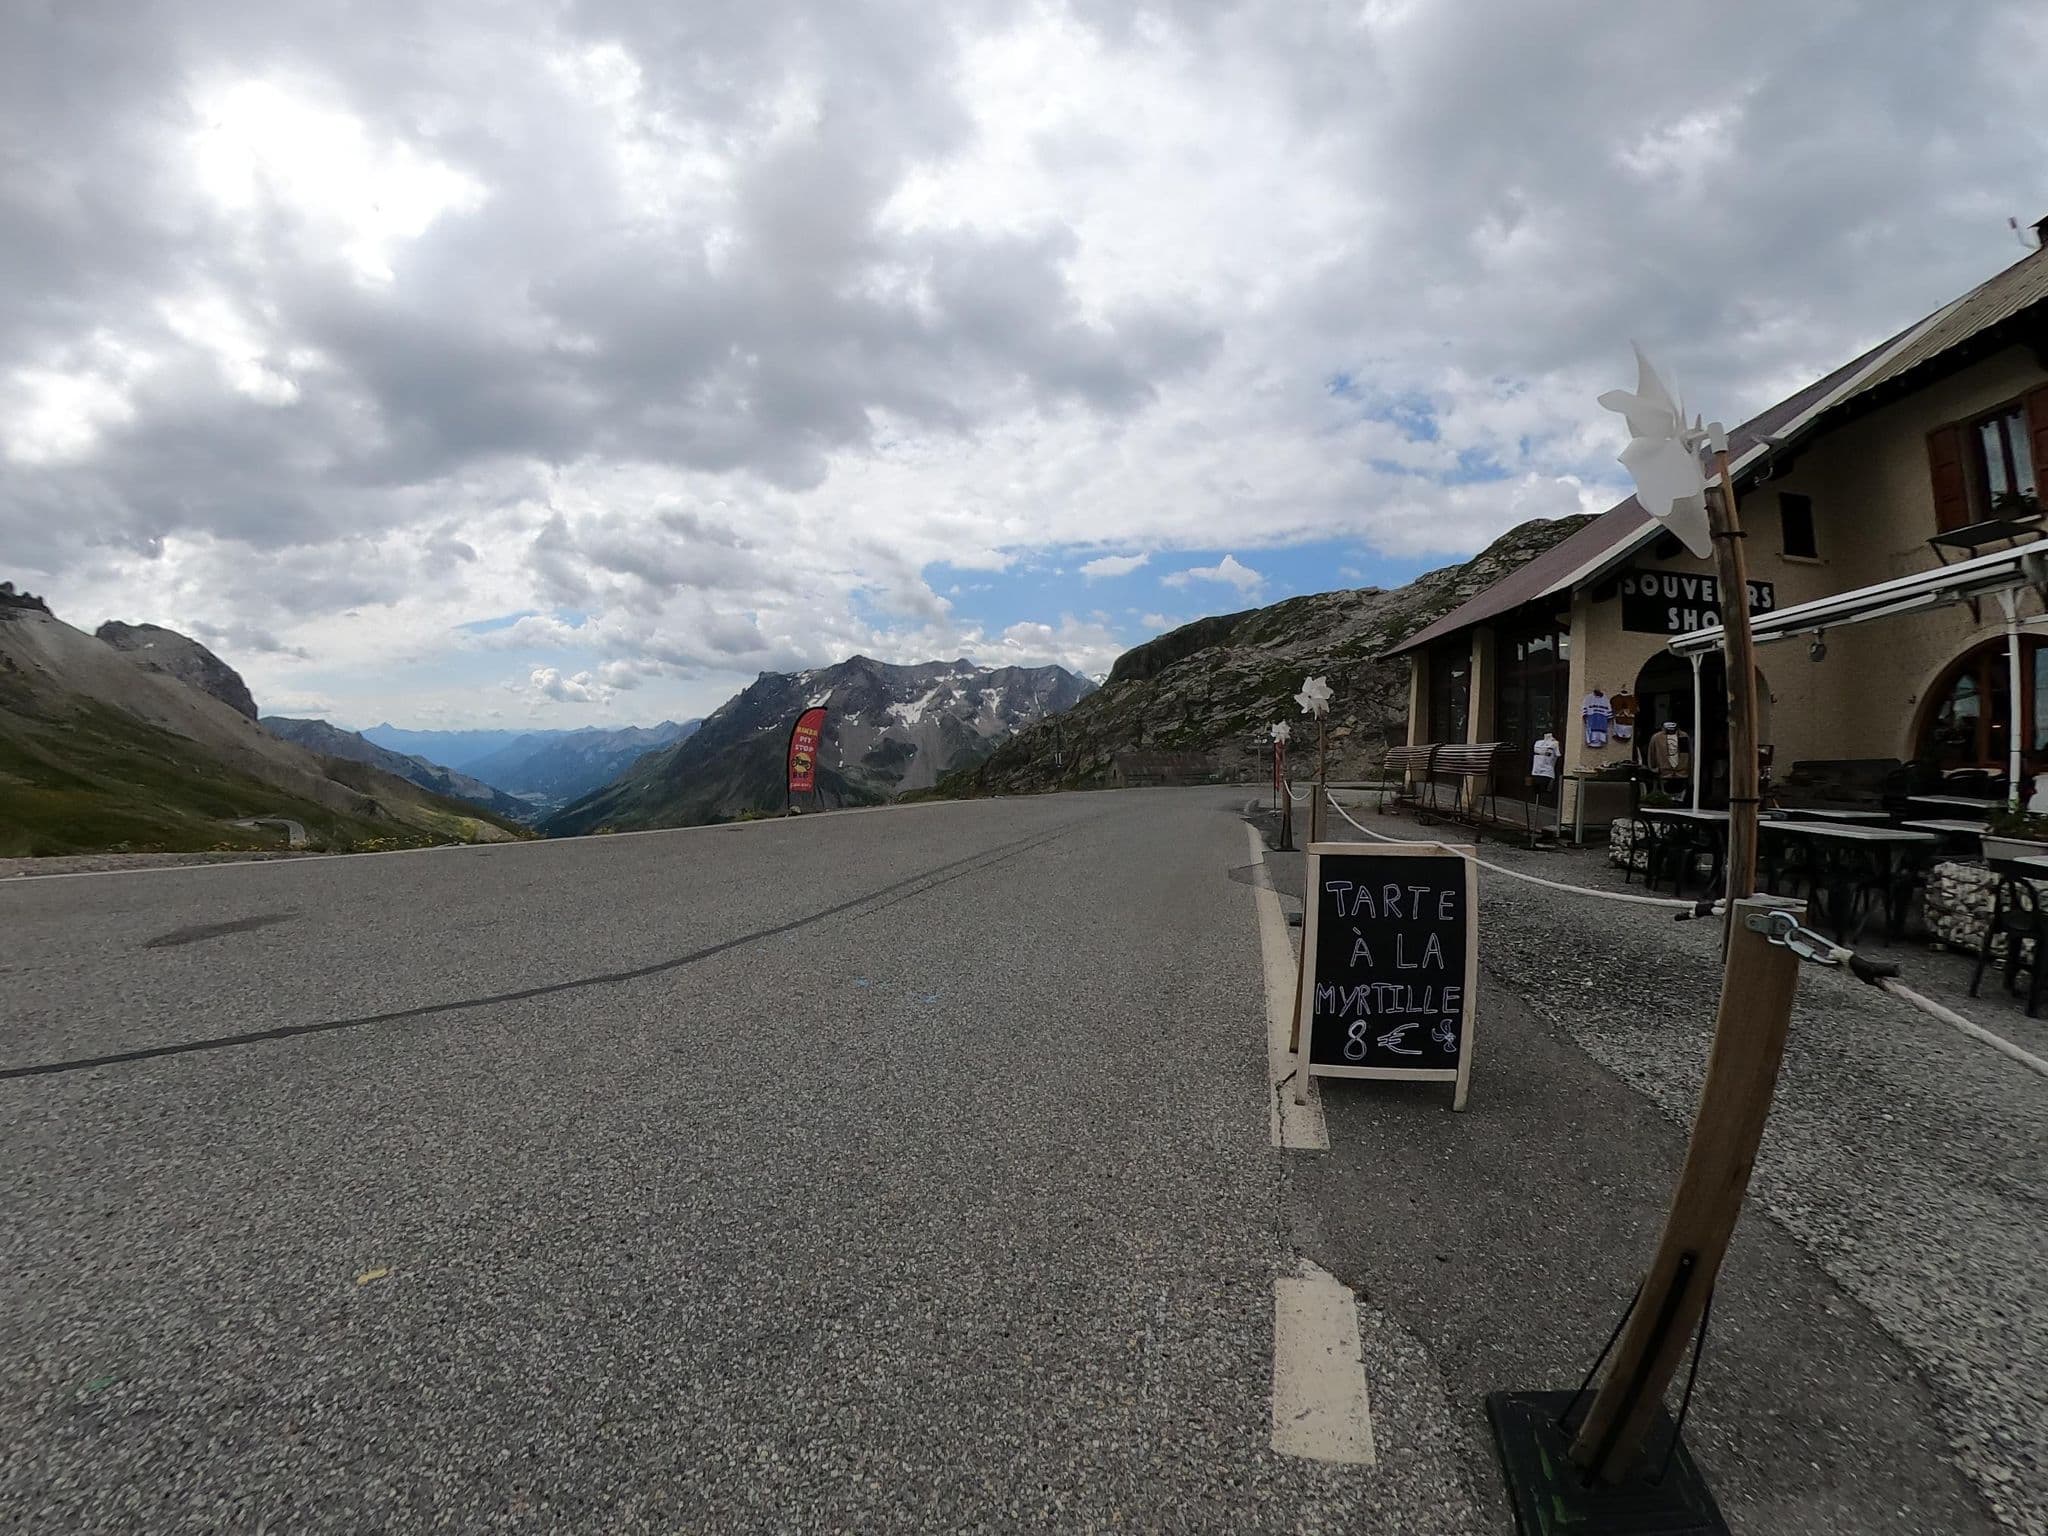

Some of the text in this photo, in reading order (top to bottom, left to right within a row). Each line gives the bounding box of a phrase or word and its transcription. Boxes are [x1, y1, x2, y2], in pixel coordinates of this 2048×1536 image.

[1624, 573, 1771, 608] SOUVERS
[1668, 607, 1720, 631] SHO
[1325, 881, 1456, 920] TARTE
[1350, 926, 1444, 969] À LA
[1315, 982, 1461, 1017] MYRTILLE
